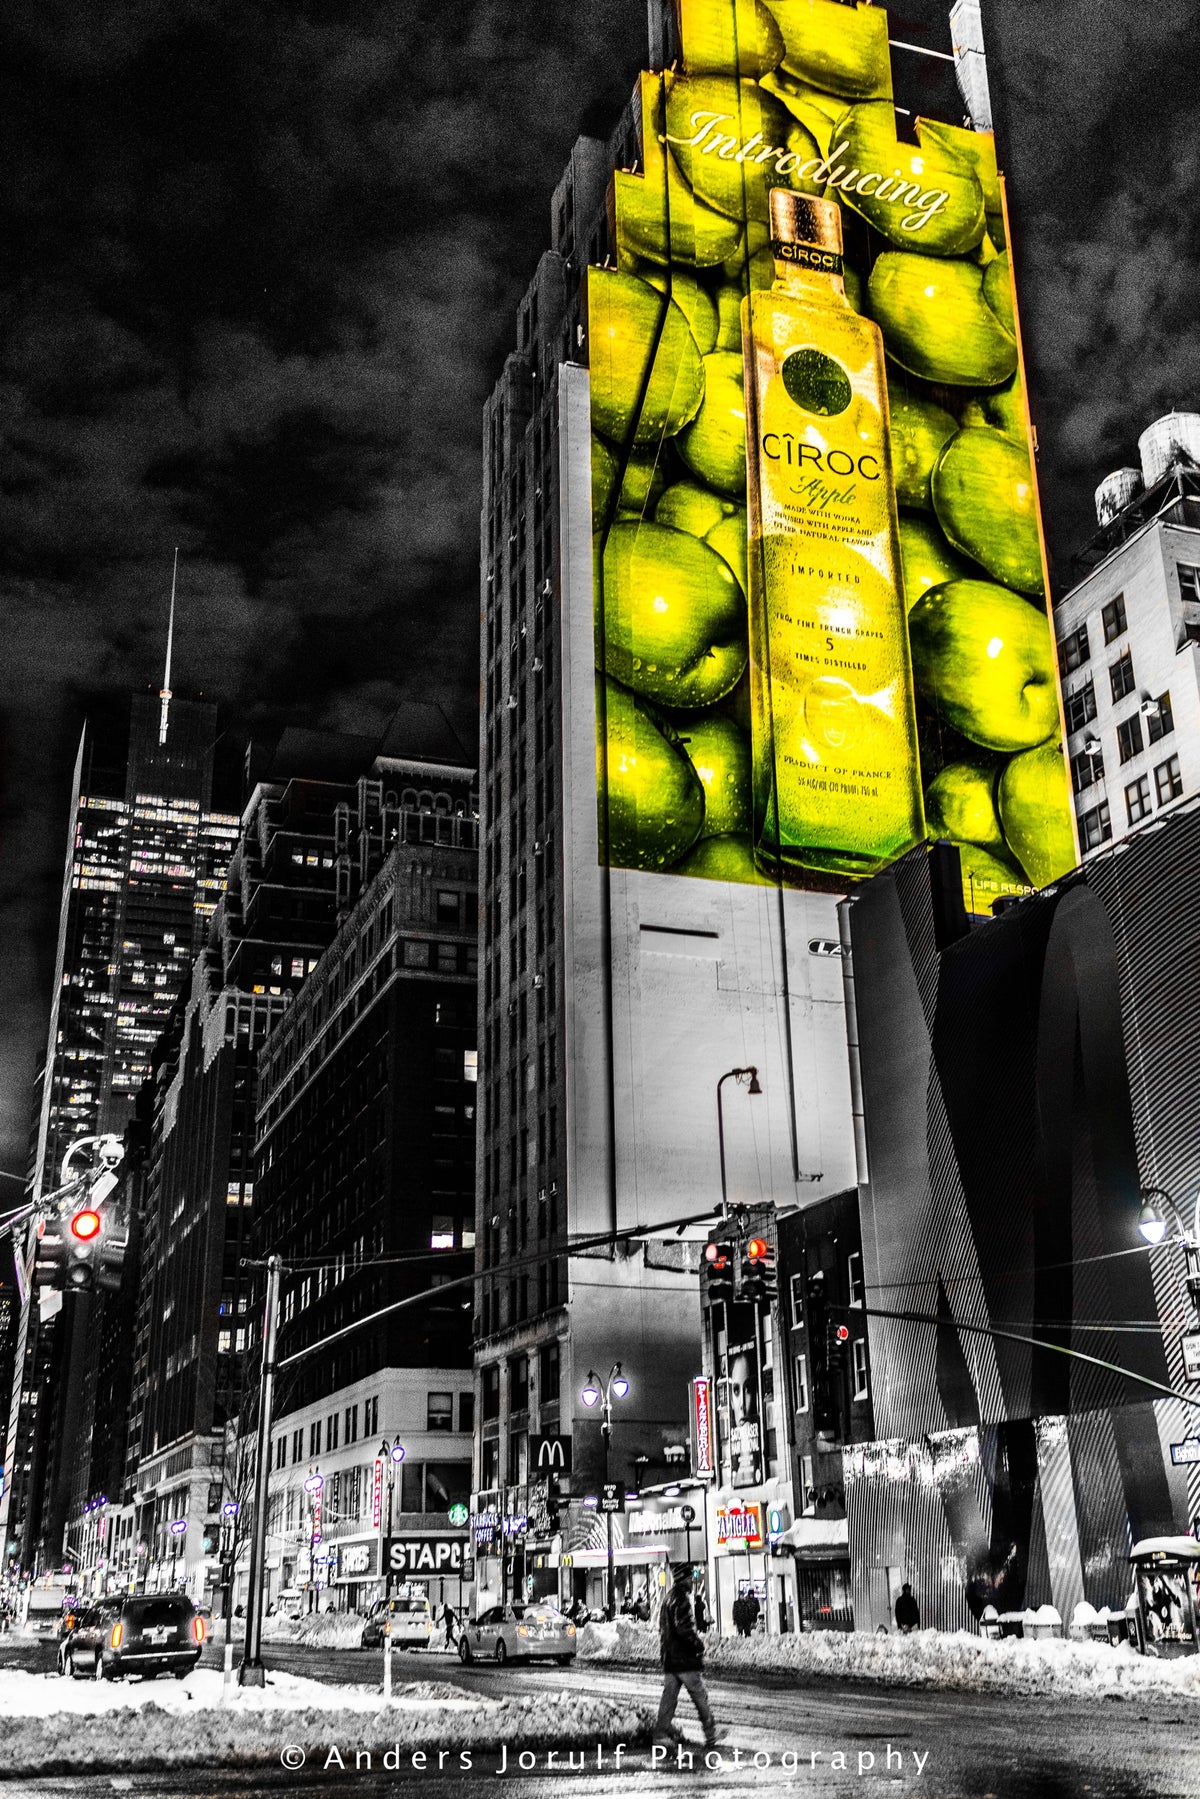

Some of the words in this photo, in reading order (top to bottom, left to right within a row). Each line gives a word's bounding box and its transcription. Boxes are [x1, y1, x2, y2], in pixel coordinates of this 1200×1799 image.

[658, 110, 950, 232] Introducing
[762, 432, 880, 480] CÎROC
[789, 475, 857, 509] Apple
[784, 504, 806, 514] MADE
[808, 509, 831, 518] WITH
[833, 513, 861, 524] VODKA
[799, 529, 840, 542] NATURAL
[842, 537, 875, 547] FLAVORS
[807, 520, 829, 530] WITH
[831, 524, 854, 533] APPLE
[856, 528, 873, 536] AND
[791, 564, 860, 584] IMPORTED
[775, 612, 793, 624] FROM
[797, 619, 815, 629] FINE
[820, 623, 852, 635] FRENCH
[855, 629, 884, 639] GRAPES
[825, 637, 834, 651] 5
[795, 652, 820, 664] TIMES
[824, 658, 867, 671] DISTILLED
[784, 755, 828, 772] PRODUCT
[833, 767, 848, 775] OF
[852, 770, 892, 779] FRANCE
[974, 879, 999, 891] LIFE
[697, 1383, 709, 1470] PIZZERIA
[470, 1513, 498, 1529] STARBUCKS
[475, 1528, 493, 1542] COFFEE
